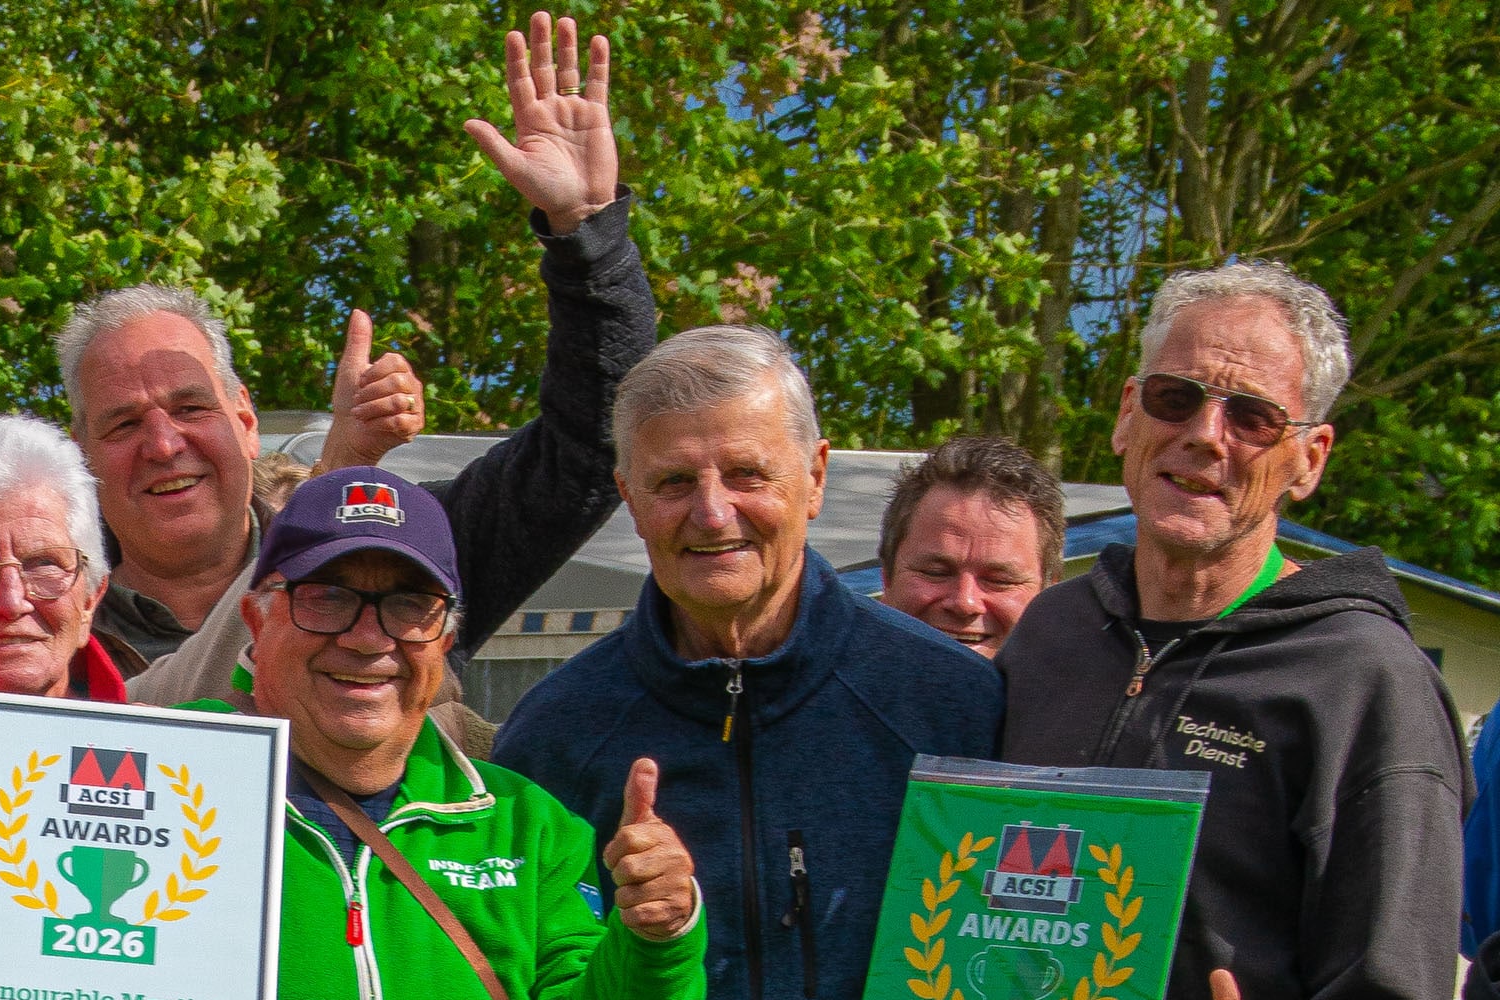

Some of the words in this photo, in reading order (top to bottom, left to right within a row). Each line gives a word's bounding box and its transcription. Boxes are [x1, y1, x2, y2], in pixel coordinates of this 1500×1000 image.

[1176, 715, 1267, 753] Technische
[1184, 739, 1248, 769] Dienst
[40, 817, 171, 848] AWARDS
[443, 871, 517, 890] TEAM
[52, 924, 145, 958] 2026
[958, 914, 1091, 948] AWARDS
